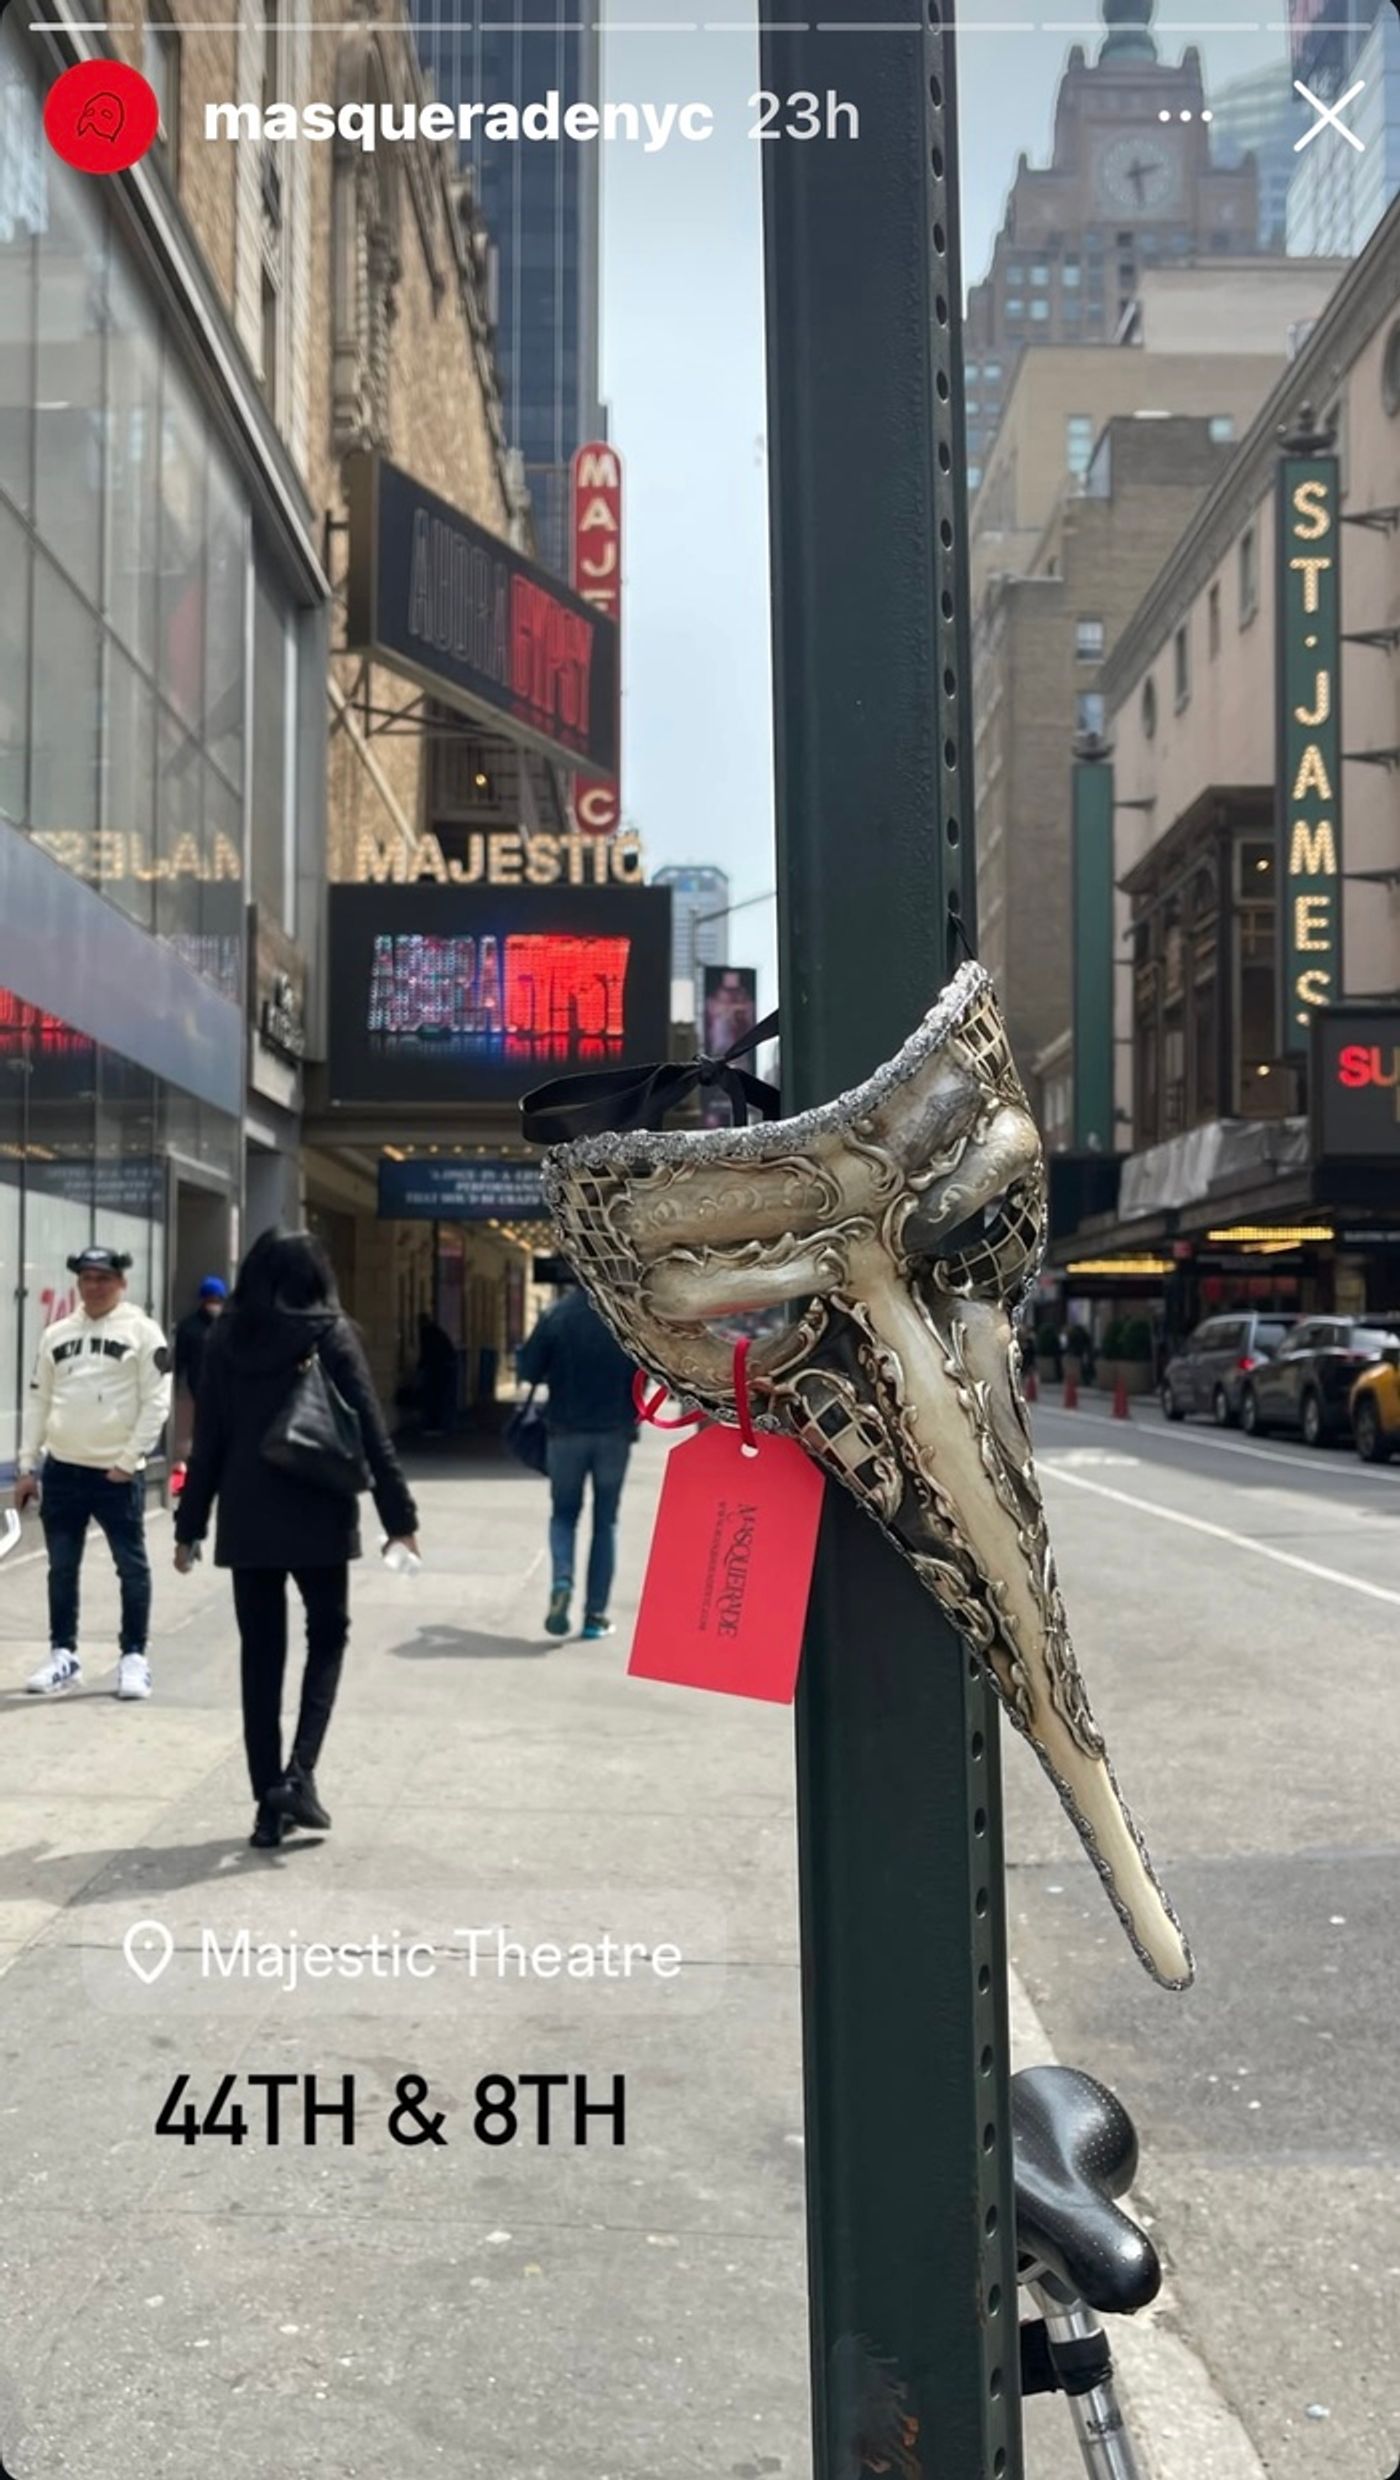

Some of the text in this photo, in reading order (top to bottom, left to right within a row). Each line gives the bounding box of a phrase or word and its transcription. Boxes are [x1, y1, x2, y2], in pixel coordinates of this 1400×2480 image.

[353, 832, 644, 884] MAJESTIC
[1289, 670, 1338, 1027] JAMES
[716, 1502, 759, 1639] MASQUERADE
